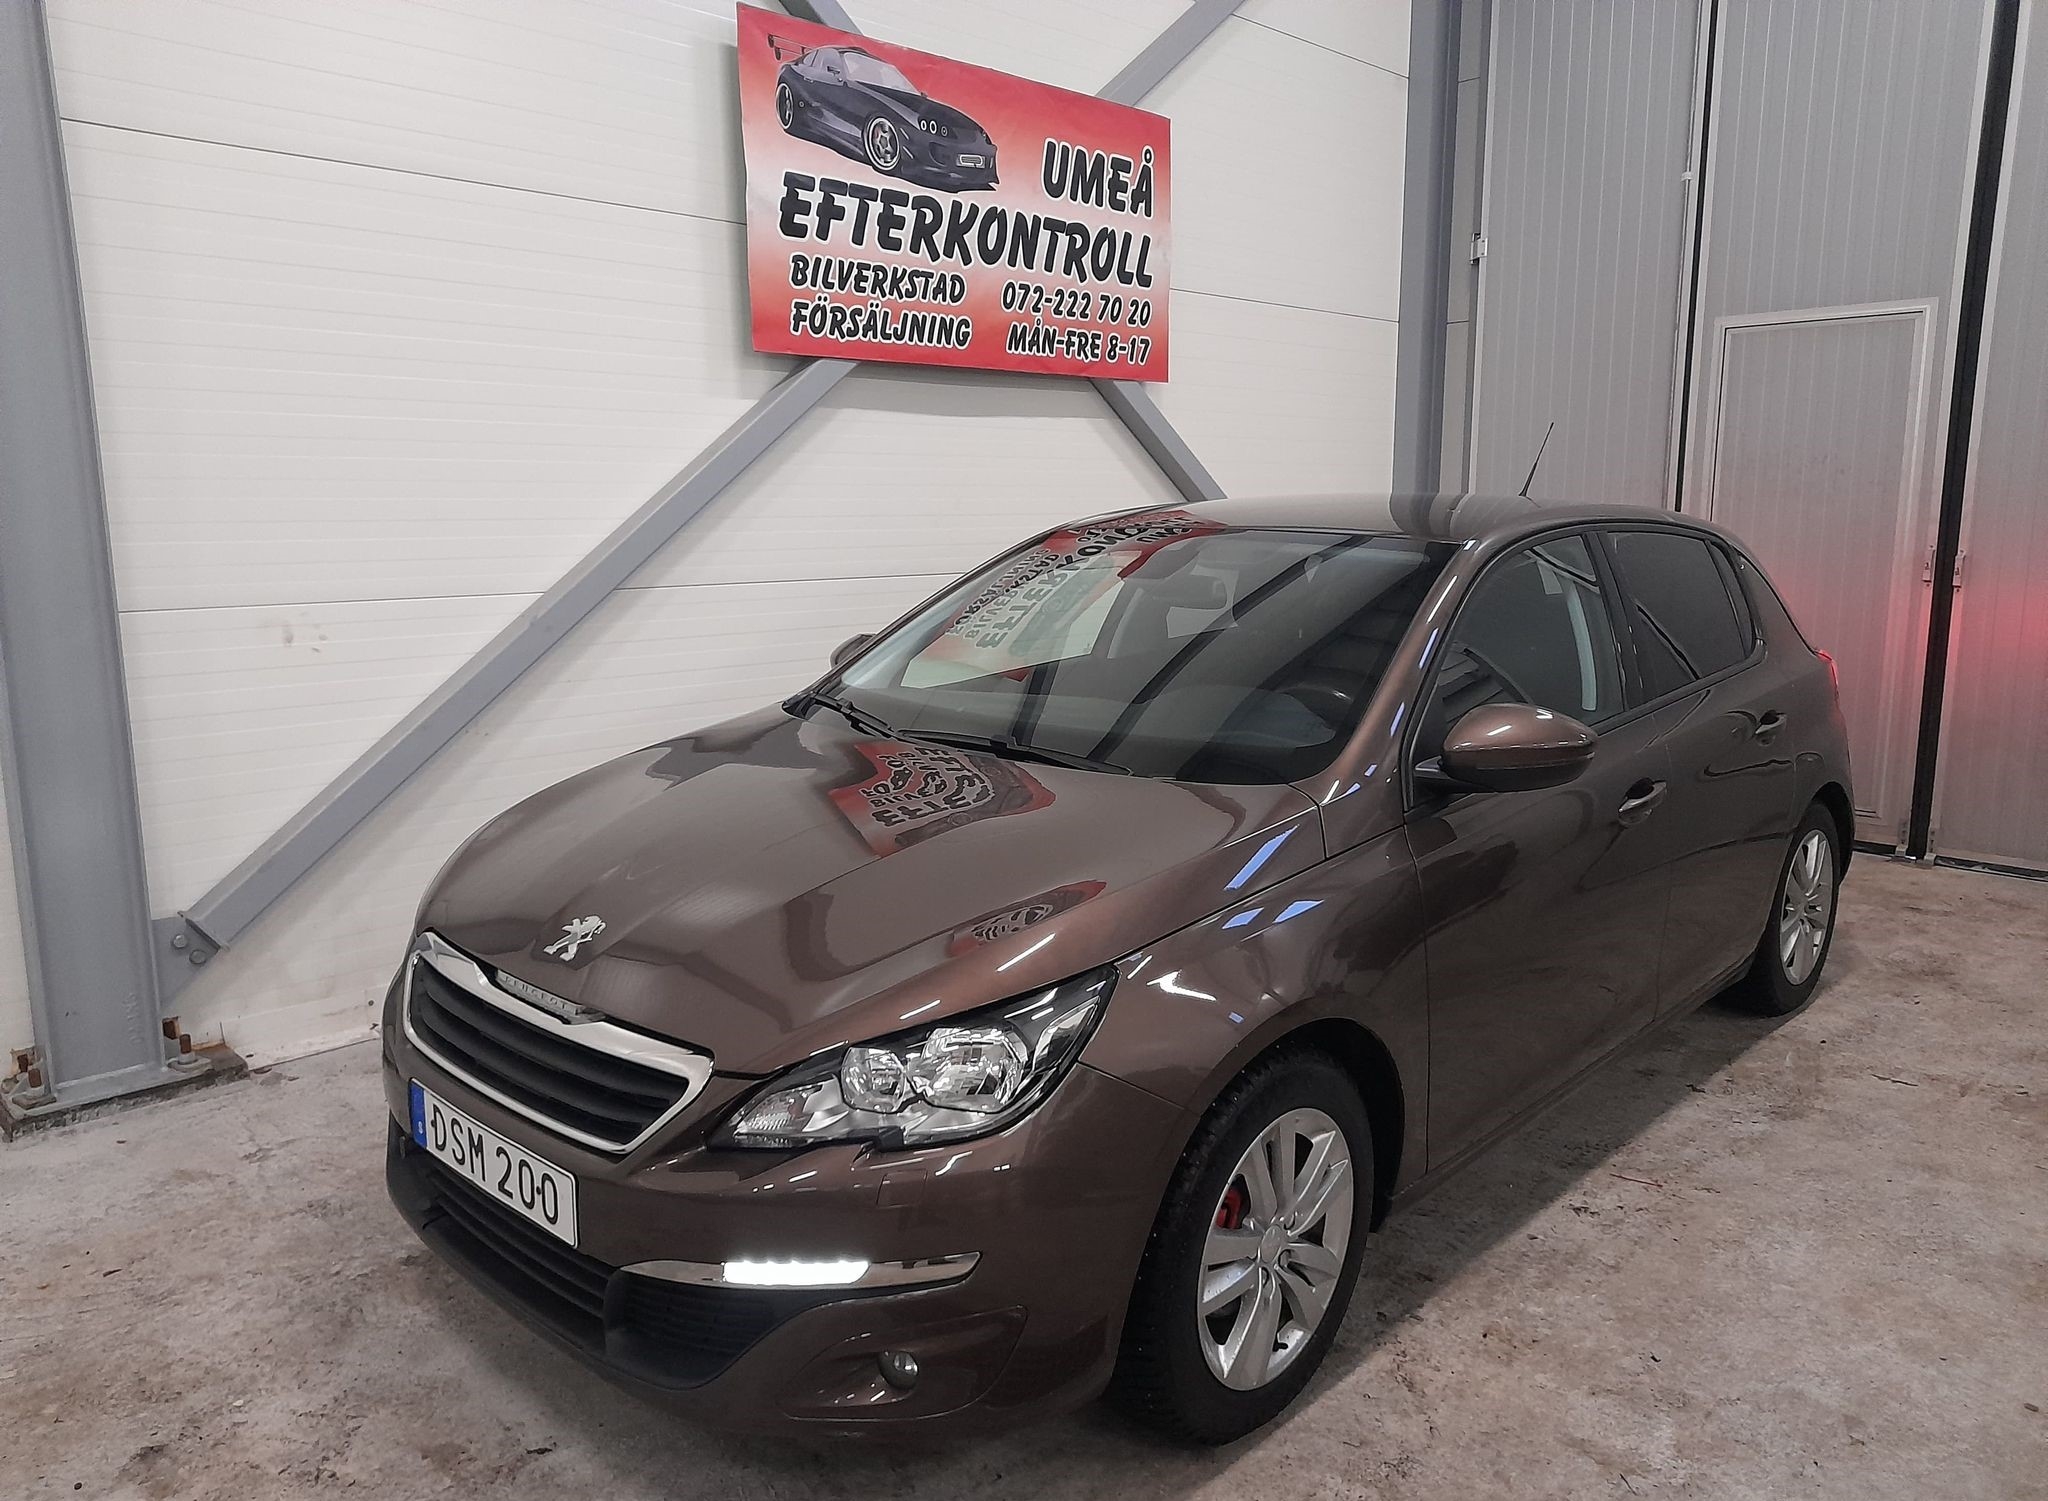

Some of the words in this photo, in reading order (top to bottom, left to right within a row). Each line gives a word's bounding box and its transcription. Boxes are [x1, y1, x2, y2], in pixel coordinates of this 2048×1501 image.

[1043, 140, 1152, 218] UMEÅ
[779, 171, 1153, 288] EFTERKONTROLL
[791, 254, 966, 304] BILVERKSTAD
[1002, 281, 1092, 320] 072-222
[1098, 294, 1123, 323] 70
[1127, 299, 1151, 327] 20
[792, 295, 971, 348] FÖRSÄLJNING
[1006, 318, 1102, 361] MÅN-FRE
[1105, 335, 1151, 364] 8-17
[432, 1103, 487, 1182] DSM
[496, 1146, 559, 1225] 200
